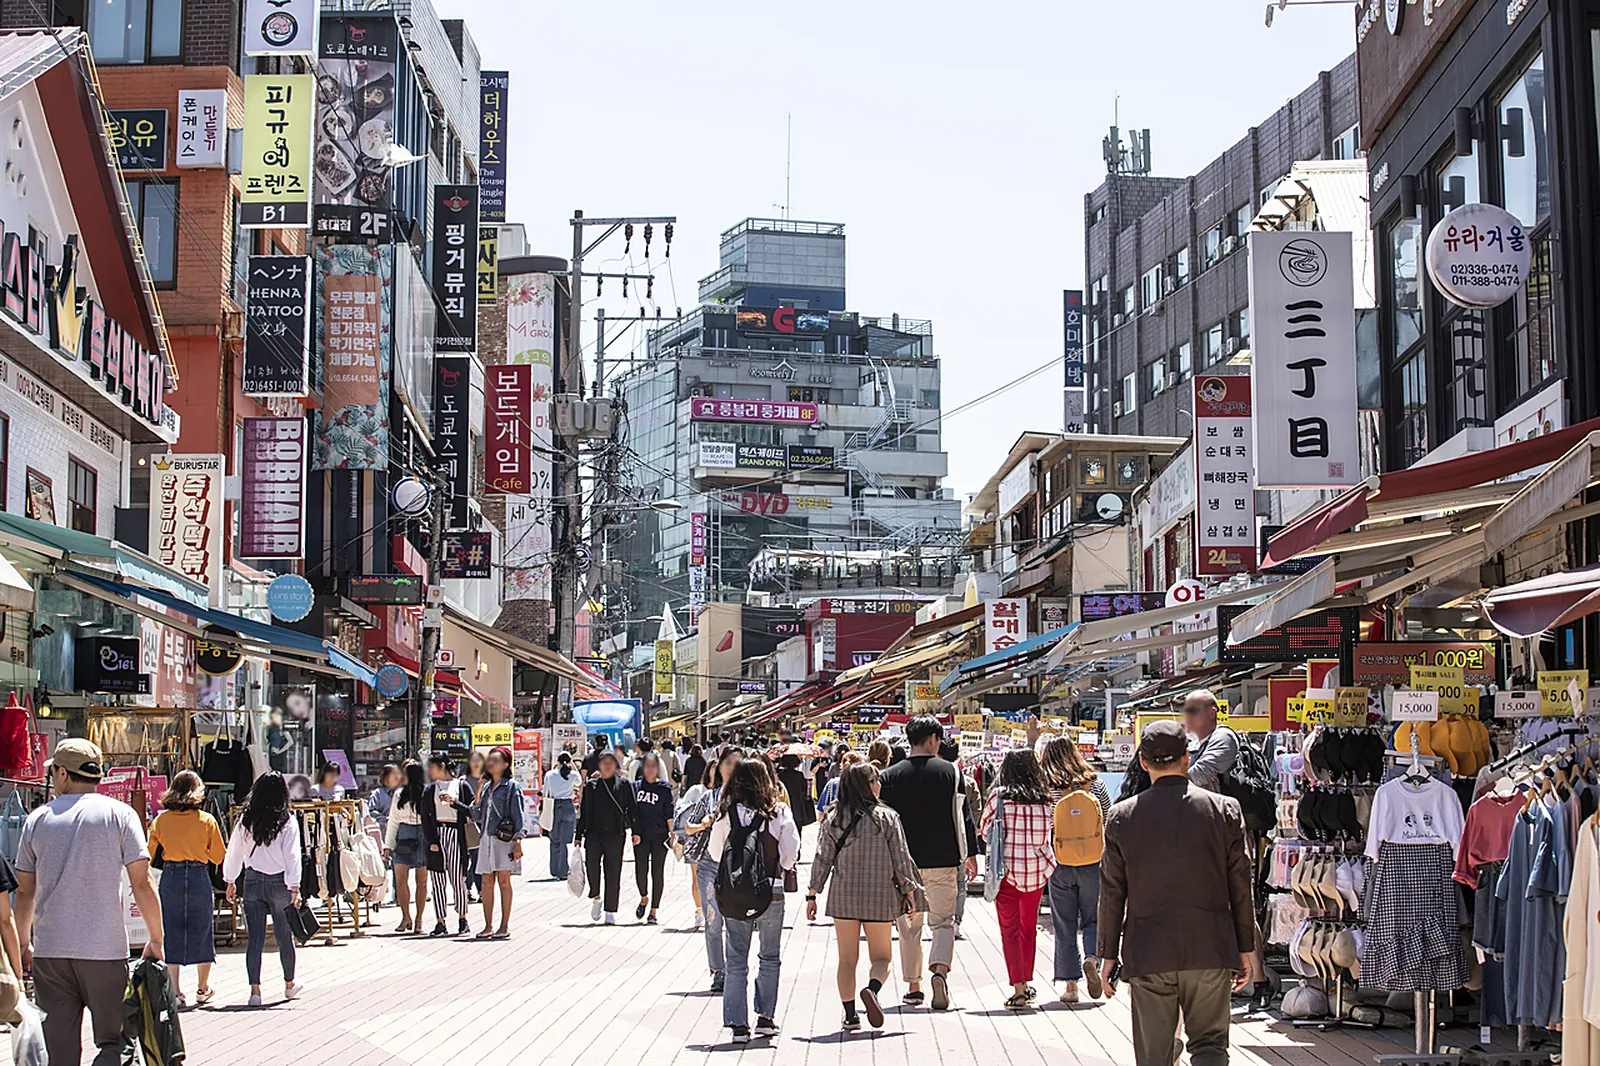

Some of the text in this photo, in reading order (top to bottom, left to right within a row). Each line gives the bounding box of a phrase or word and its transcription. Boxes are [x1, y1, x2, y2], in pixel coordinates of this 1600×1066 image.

[181, 98, 198, 158] 폰케이스
[204, 105, 217, 151] 만들기
[263, 84, 292, 168] 피규어
[482, 91, 501, 164] 더하우스
[246, 174, 305, 195] 프렌즈
[262, 206, 286, 222] B1
[360, 212, 387, 235] 2F
[254, 264, 302, 280] ヘンナ
[444, 224, 467, 318] 핑거뮤직
[1451, 264, 1519, 274] 02)336-0474
[1452, 275, 1520, 286] 011-388-0474
[250, 288, 301, 298] HENNA
[250, 305, 303, 317] TATTOO
[330, 307, 364, 320] 전문점
[330, 322, 376, 335] 핑거뮤직
[330, 337, 376, 350] 악기연주
[329, 353, 376, 367] 체험가능
[1284, 300, 1329, 458] 三丁目
[801, 409, 814, 419] 8F
[496, 371, 521, 473] 보드게임
[175, 461, 219, 470] BURUSTAR
[494, 477, 522, 489] Cafe
[1204, 472, 1248, 484] 뼈해장국
[741, 492, 789, 516] DVD
[163, 631, 195, 685] 부동산
[1399, 703, 1432, 714] 15,000
[1502, 702, 1535, 712] 15,000
[637, 790, 659, 805] GAP
